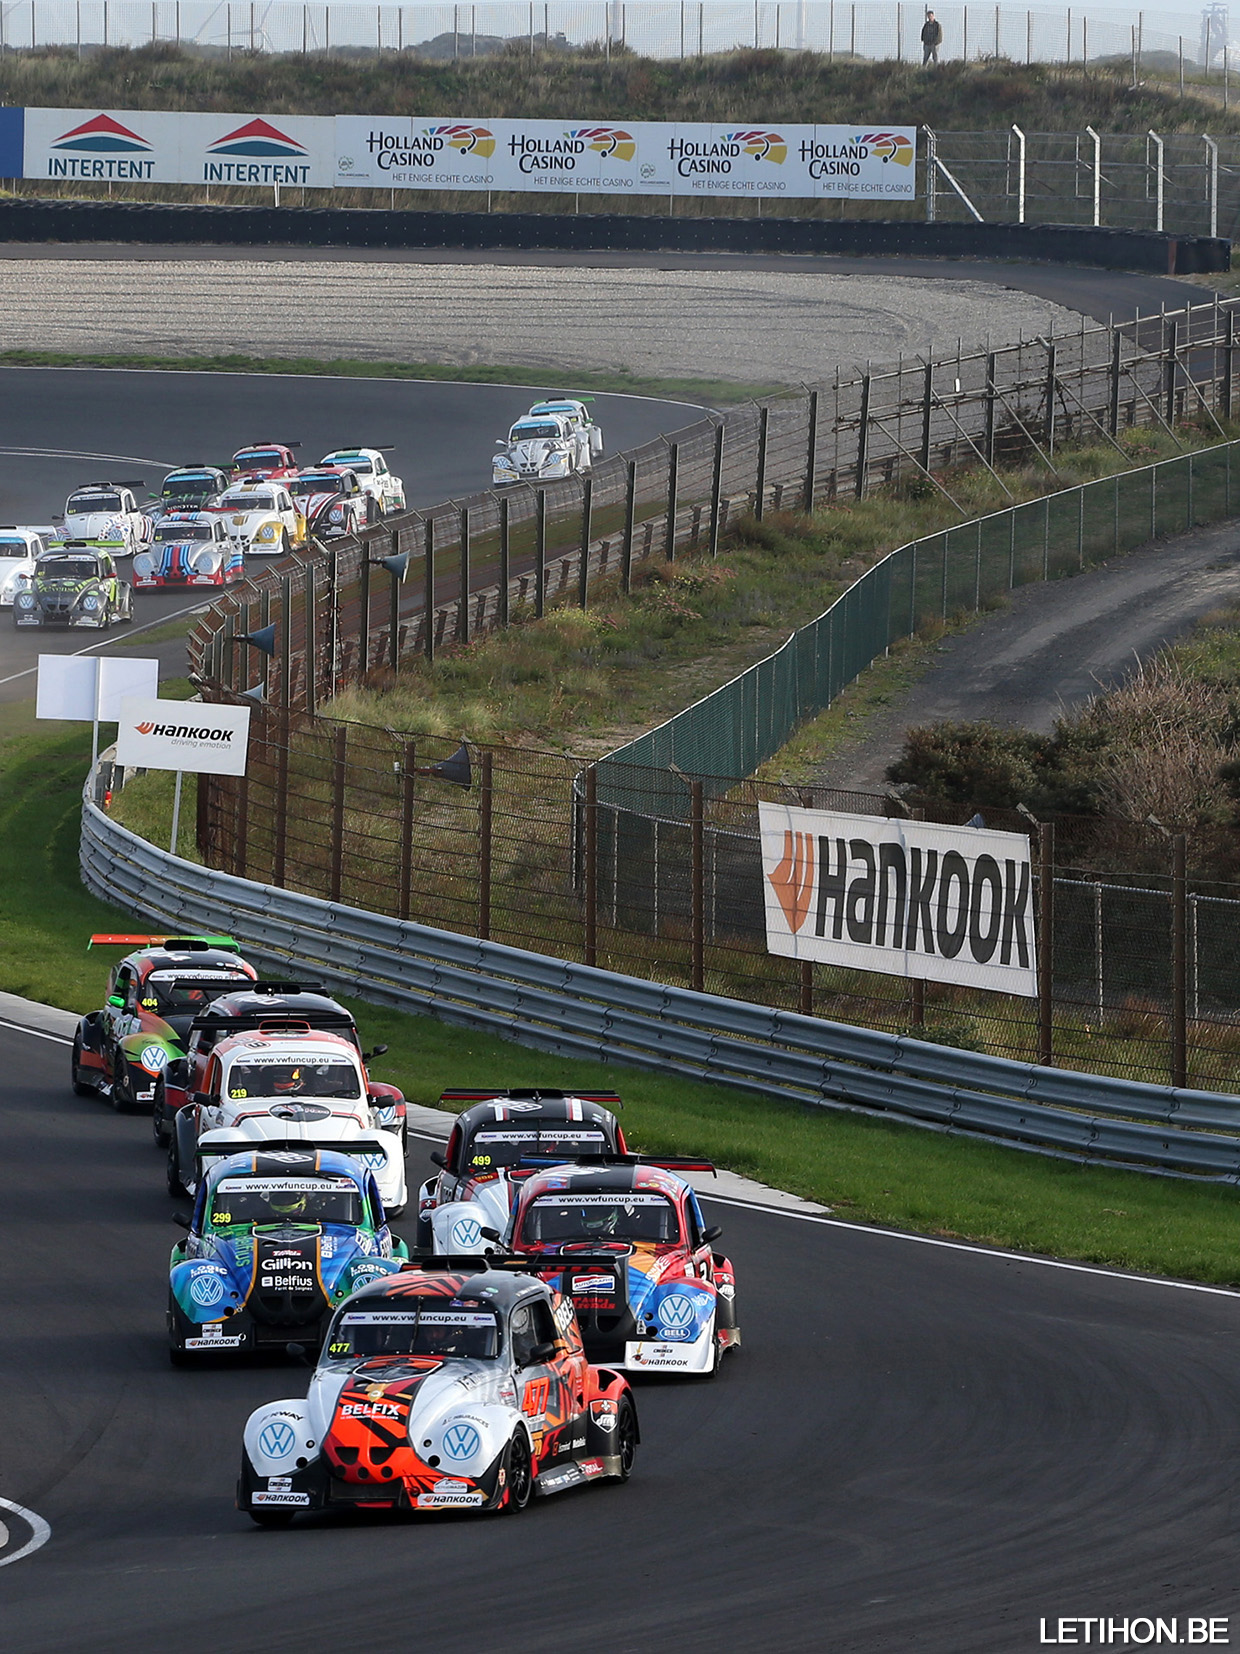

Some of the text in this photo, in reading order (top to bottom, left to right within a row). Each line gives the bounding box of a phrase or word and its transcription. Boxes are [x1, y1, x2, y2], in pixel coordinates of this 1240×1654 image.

[366, 131, 444, 152] HOLLAND
[507, 134, 585, 155] HOLLAND
[667, 138, 740, 160] HOLLAND
[798, 140, 868, 161] HOLLAND
[377, 151, 435, 170] CASINO
[518, 154, 576, 173] CASINO
[48, 158, 155, 179] INTERTENT
[677, 157, 732, 177] CASINO
[809, 159, 860, 179] CASINO
[204, 163, 311, 183] INTERTENT
[392, 173, 494, 184] HET ENIGE ECHTE CASINO
[534, 176, 548, 185] HET
[576, 177, 600, 187] ECHTE
[602, 178, 634, 187] CASINO
[692, 180, 706, 189] HET
[732, 181, 755, 190] ECHTE
[756, 181, 786, 191] CASINO
[822, 182, 835, 191] HET
[861, 183, 883, 193] ECHTE
[885, 184, 912, 193] CASINO
[171, 739, 231, 750] driving emotion
[142, 998, 158, 1007] 404
[254, 1056, 330, 1065] www.vwfuncup.eu
[231, 1088, 247, 1098] 219
[502, 1132, 581, 1140] www.vwfuncup.eu
[472, 1155, 491, 1166] 499
[246, 1182, 332, 1191] www.vwfuncup.eu
[559, 1195, 645, 1205] www.vwfuncup.eu
[213, 1212, 231, 1223] 299
[261, 1257, 313, 1270] Gillion
[275, 1275, 313, 1286] Belfius
[372, 1314, 467, 1323] www.vwuncup.eu
[329, 1342, 350, 1353] 477
[522, 1376, 550, 1417] 477
[342, 1403, 401, 1416] BELFIX
